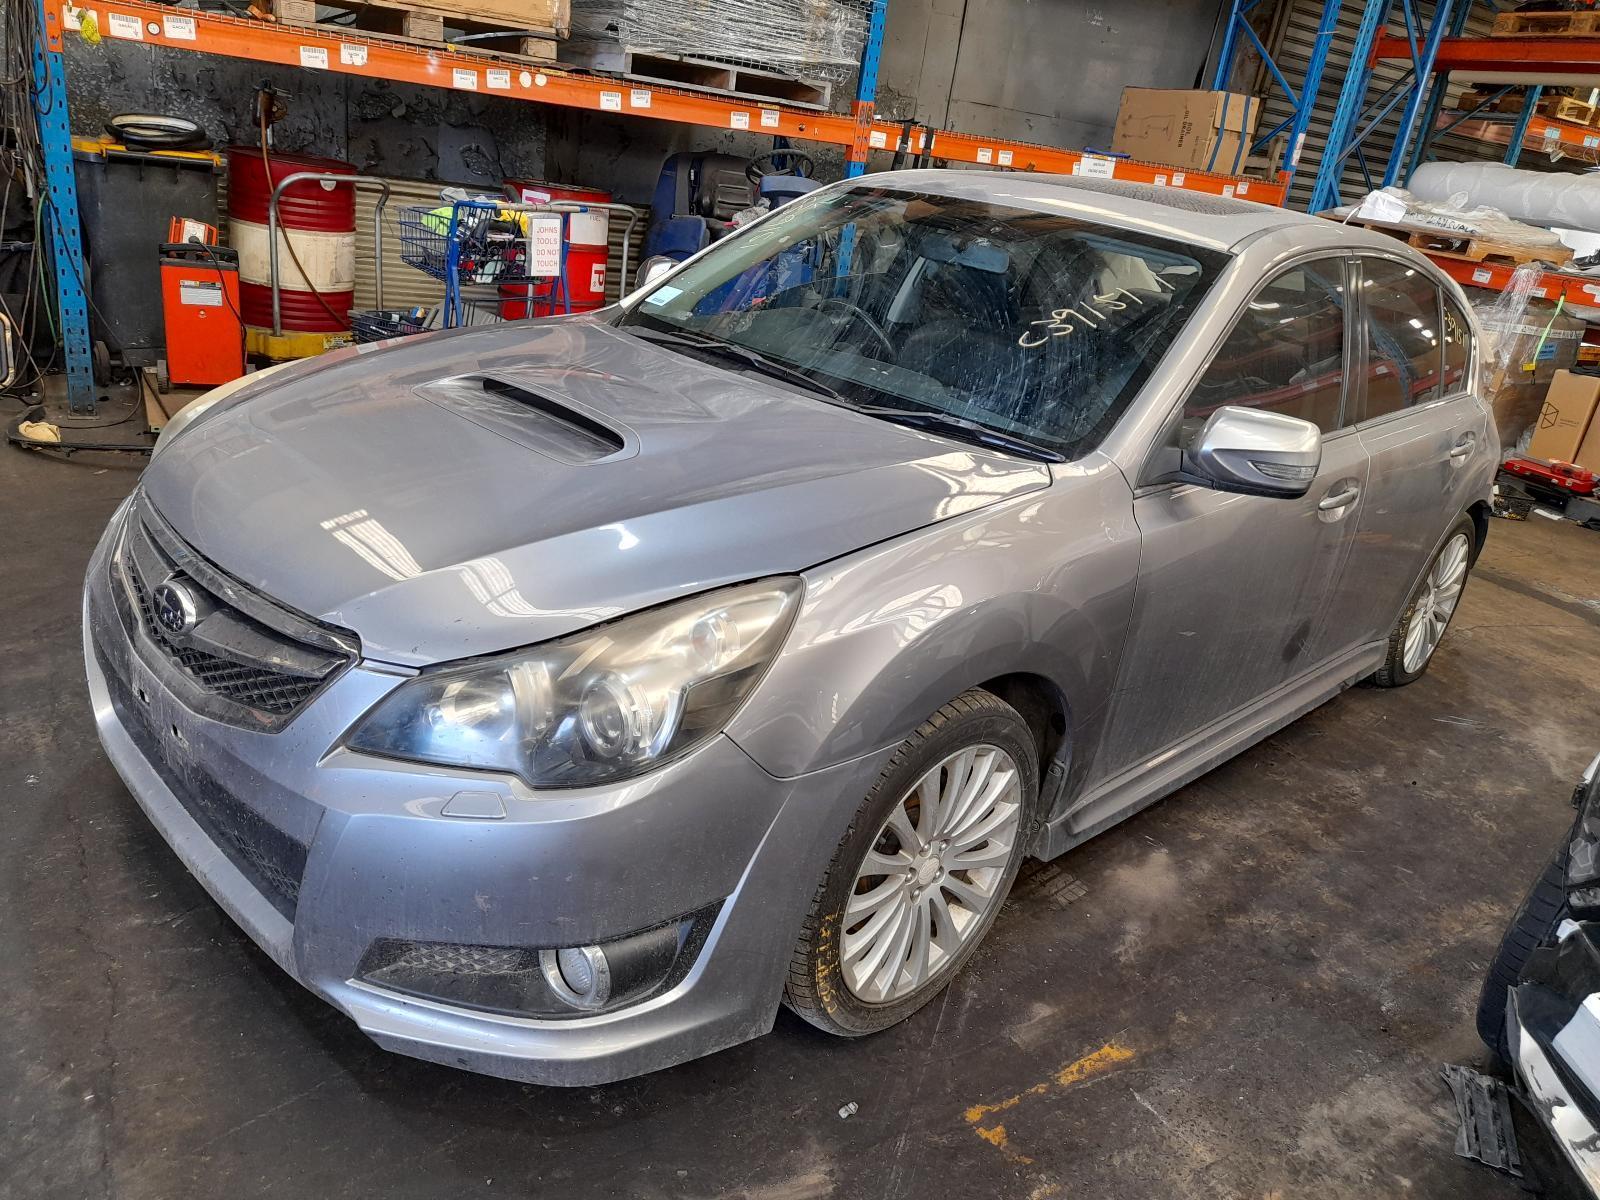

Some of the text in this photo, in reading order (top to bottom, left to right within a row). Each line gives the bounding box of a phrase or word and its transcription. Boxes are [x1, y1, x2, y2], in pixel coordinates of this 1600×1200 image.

[536, 226, 558, 234] JOHNS
[536, 237, 558, 245] TOOLS
[536, 248, 546, 256] DO
